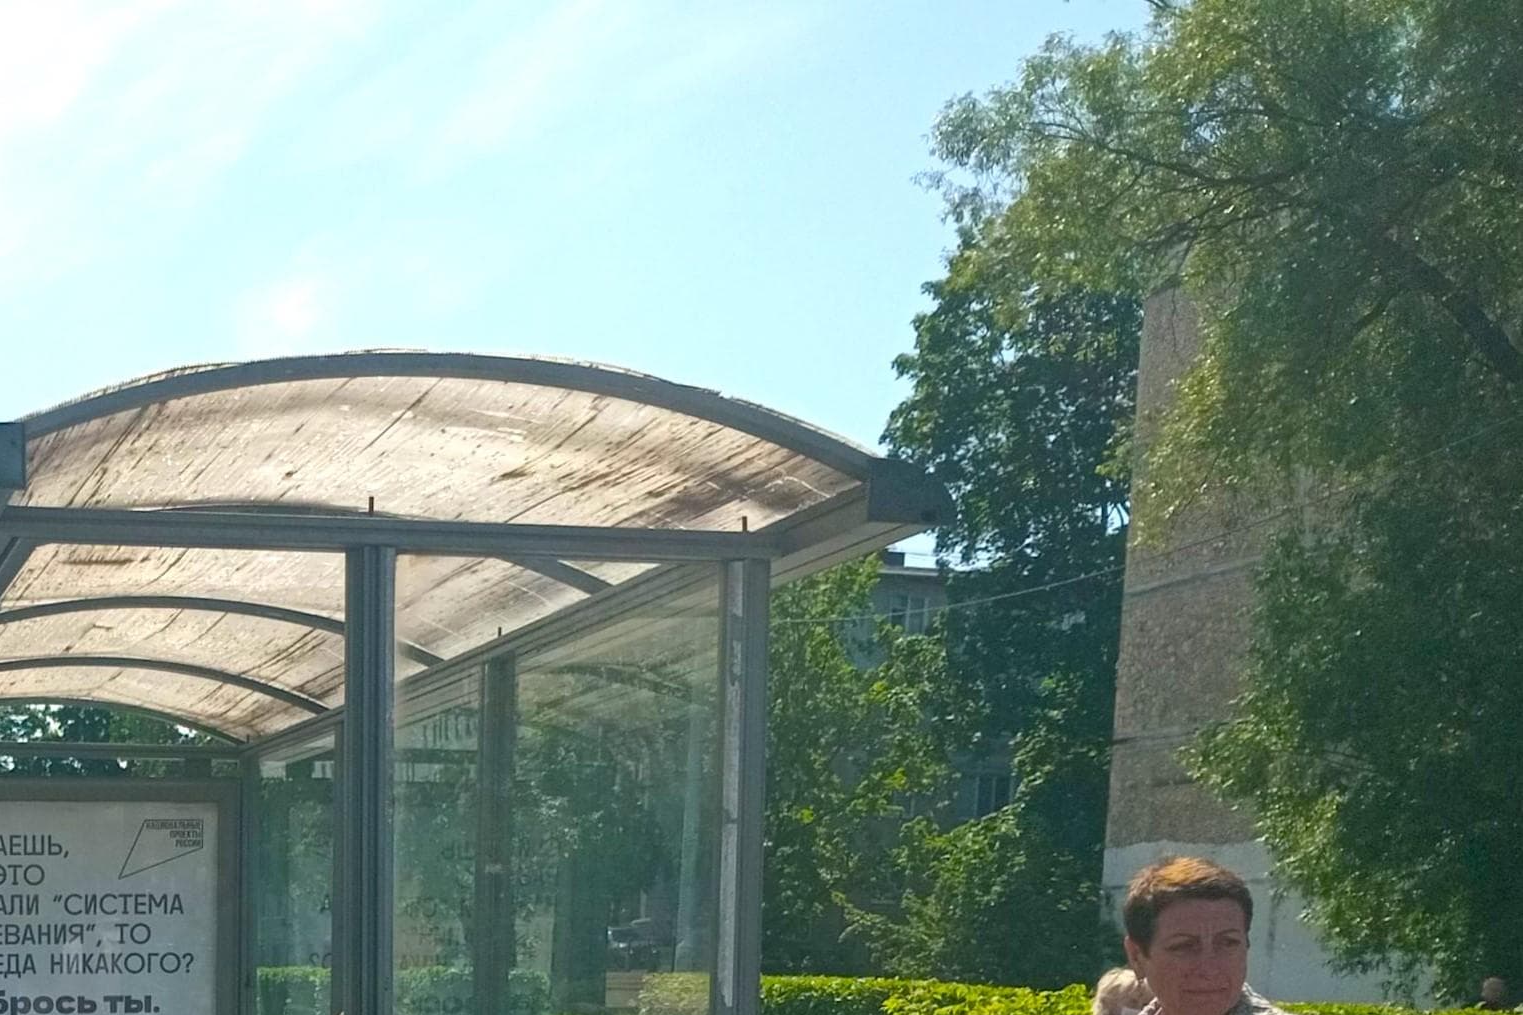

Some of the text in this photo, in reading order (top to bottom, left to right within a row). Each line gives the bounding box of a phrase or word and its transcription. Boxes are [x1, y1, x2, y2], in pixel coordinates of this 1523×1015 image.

[114, 922, 152, 945] ТО
[50, 952, 195, 975] НИКАКОГО?
[103, 994, 161, 1014] ты.
